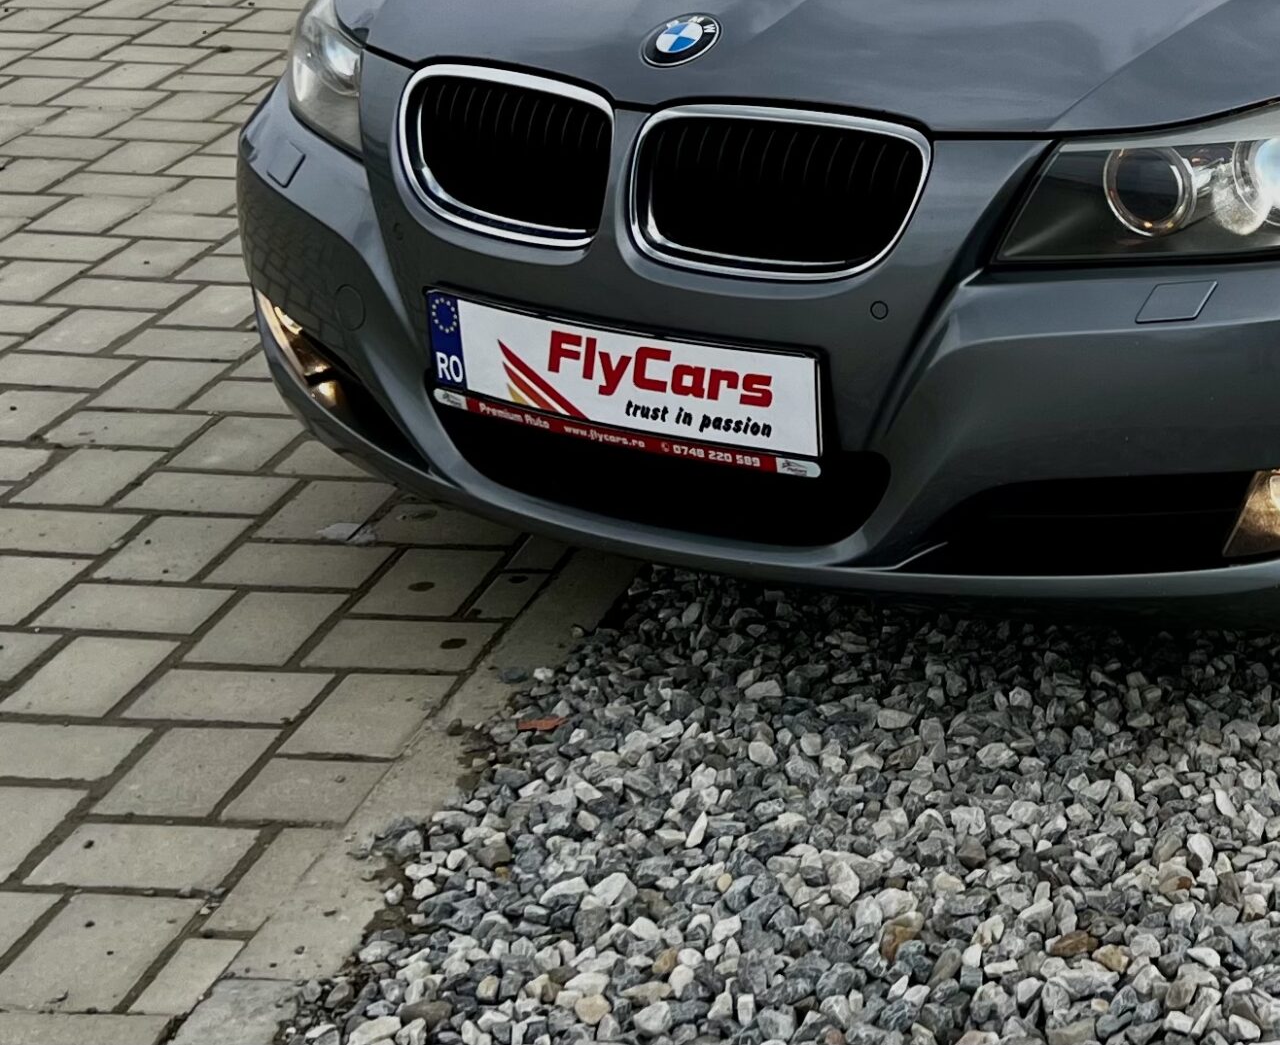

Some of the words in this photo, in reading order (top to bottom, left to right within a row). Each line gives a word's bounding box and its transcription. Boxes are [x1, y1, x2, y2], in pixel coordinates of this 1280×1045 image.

[435, 350, 464, 384] RO
[547, 329, 773, 408] FlyCars
[478, 401, 524, 423] Premium
[524, 413, 551, 430] Auto
[563, 425, 646, 449] www.flycars.ro
[707, 450, 733, 463] 220
[624, 399, 670, 423] trust
[675, 406, 693, 427] in
[698, 412, 773, 439] passion
